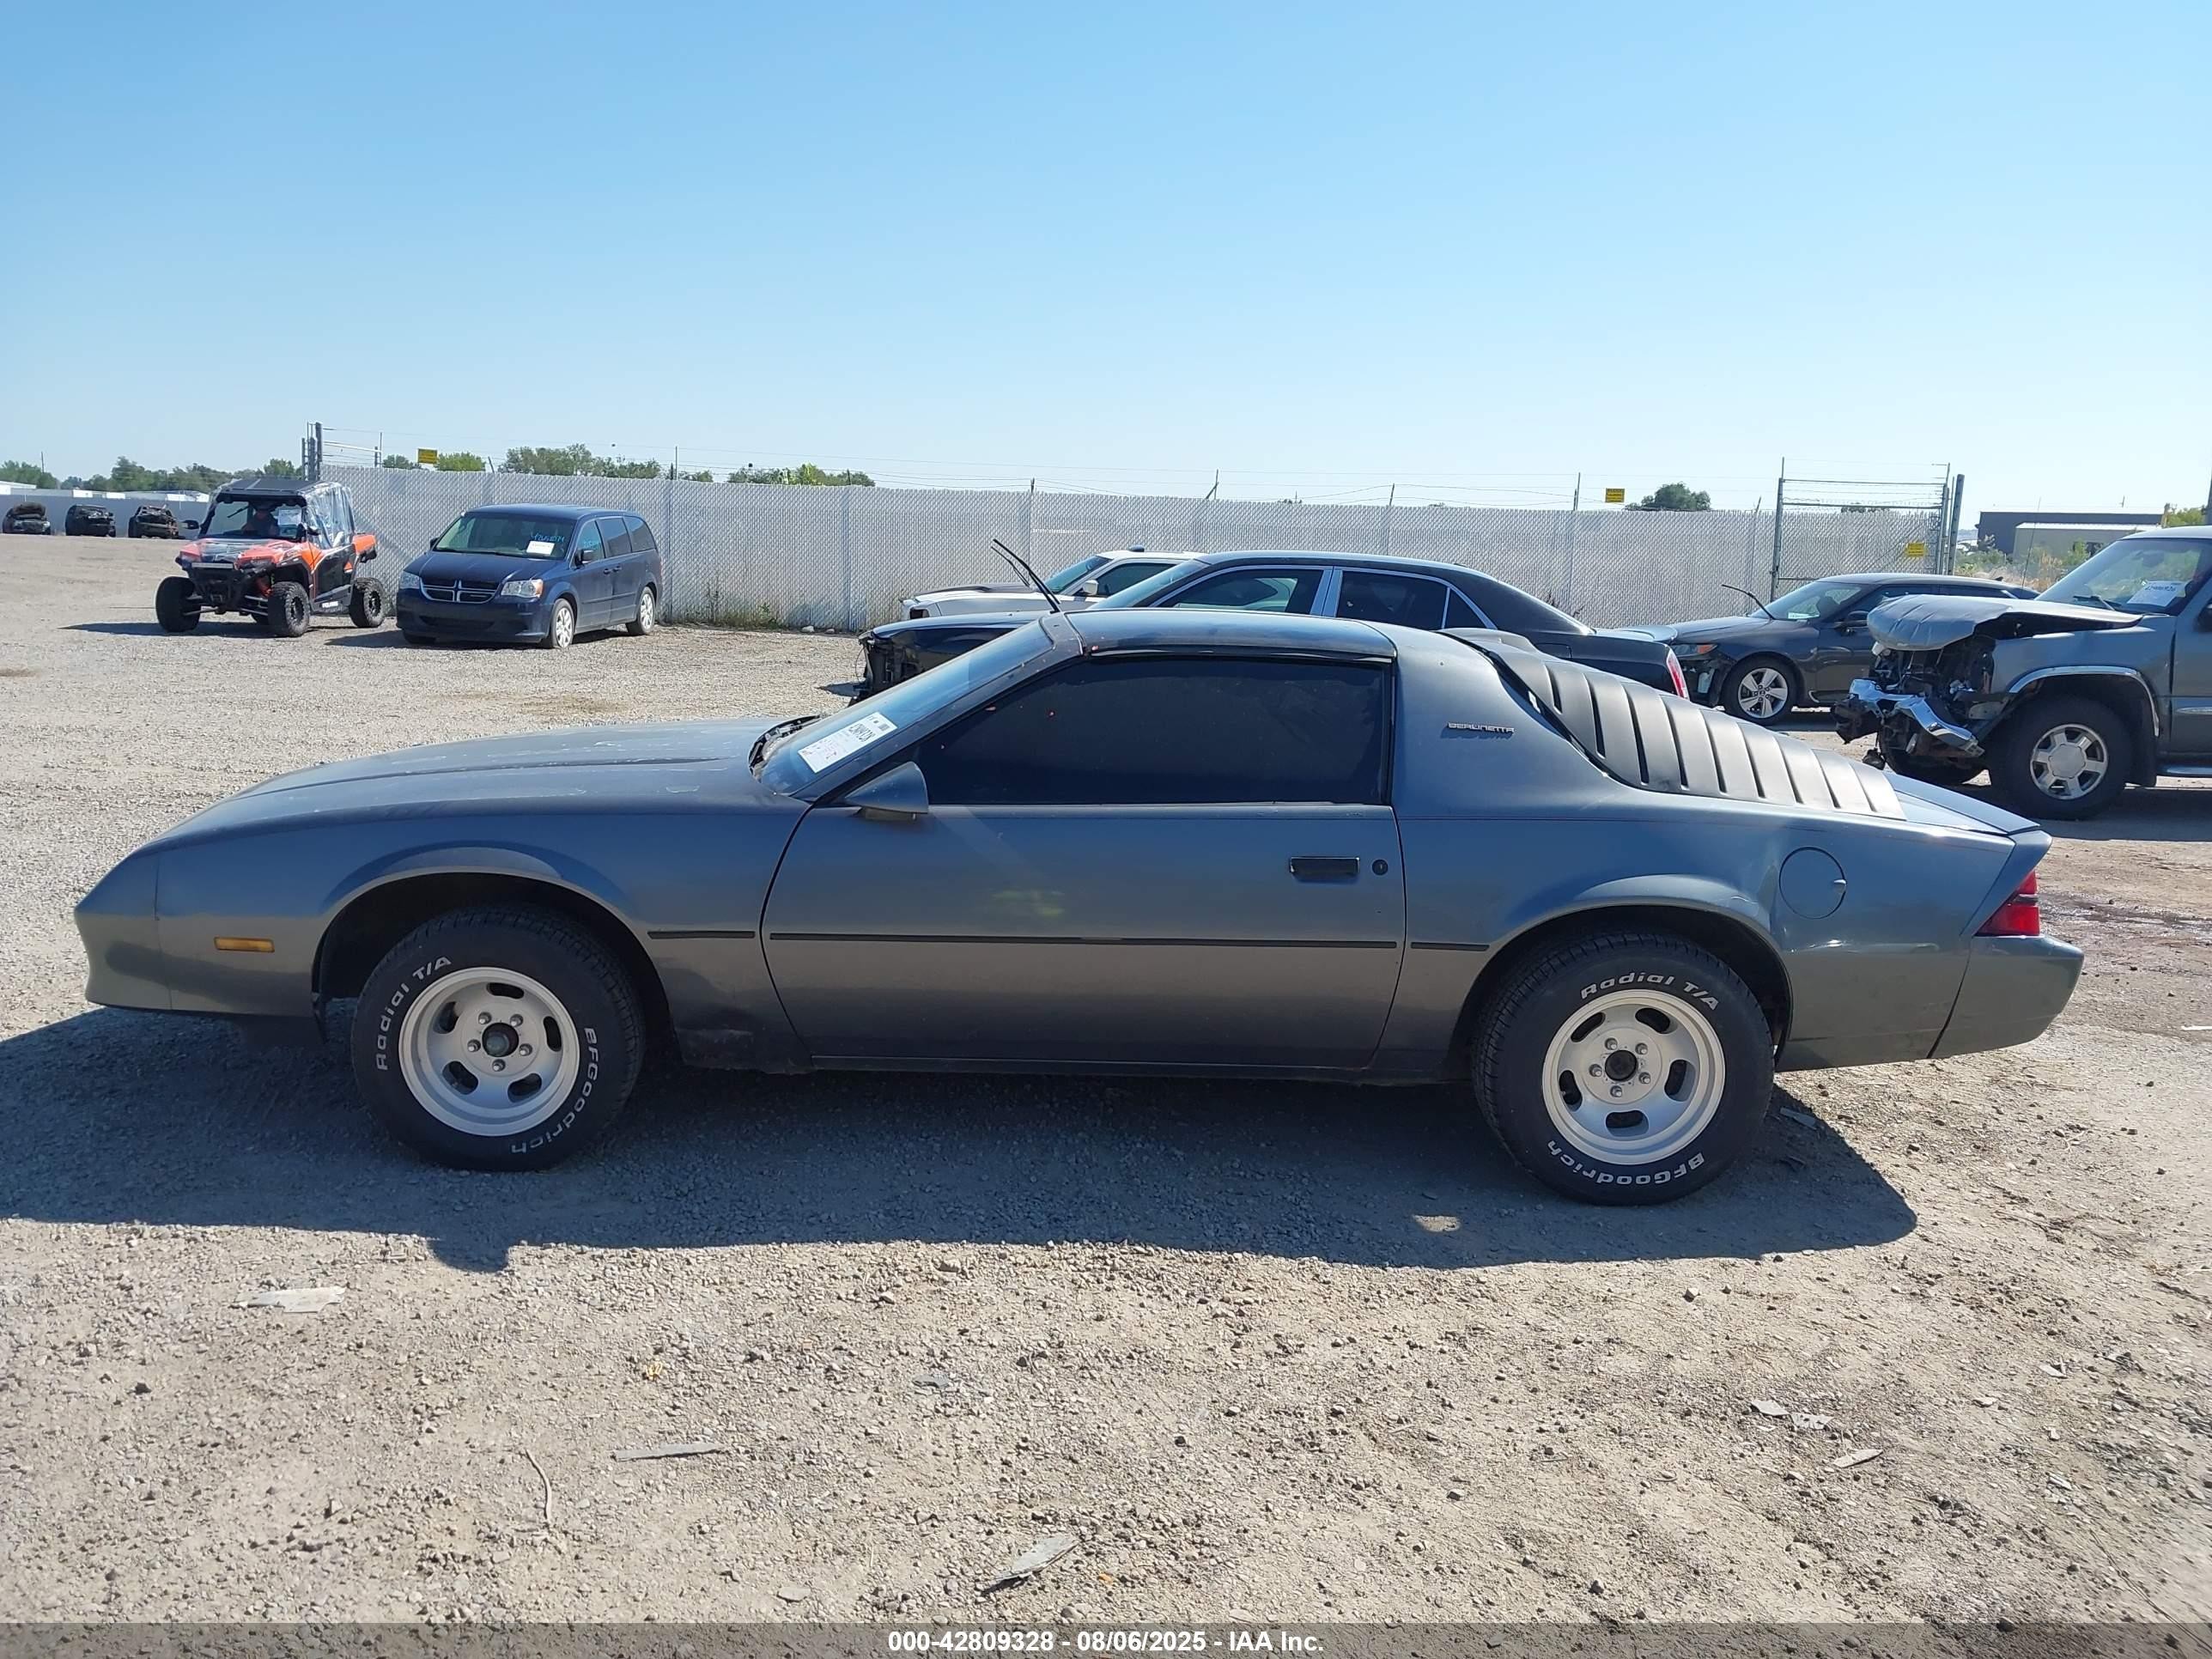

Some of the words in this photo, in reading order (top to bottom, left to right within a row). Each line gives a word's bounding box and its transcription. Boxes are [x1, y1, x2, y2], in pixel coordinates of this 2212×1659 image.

[1447, 721, 1515, 733] BERLINETTA
[375, 982, 410, 1071] Radial
[412, 956, 452, 980] T/A
[1580, 971, 1674, 1000] Radial
[1682, 981, 1720, 1012] T/A
[511, 1026, 599, 1154] BFGoodrich
[1547, 1139, 1705, 1186] BFGoodrich
